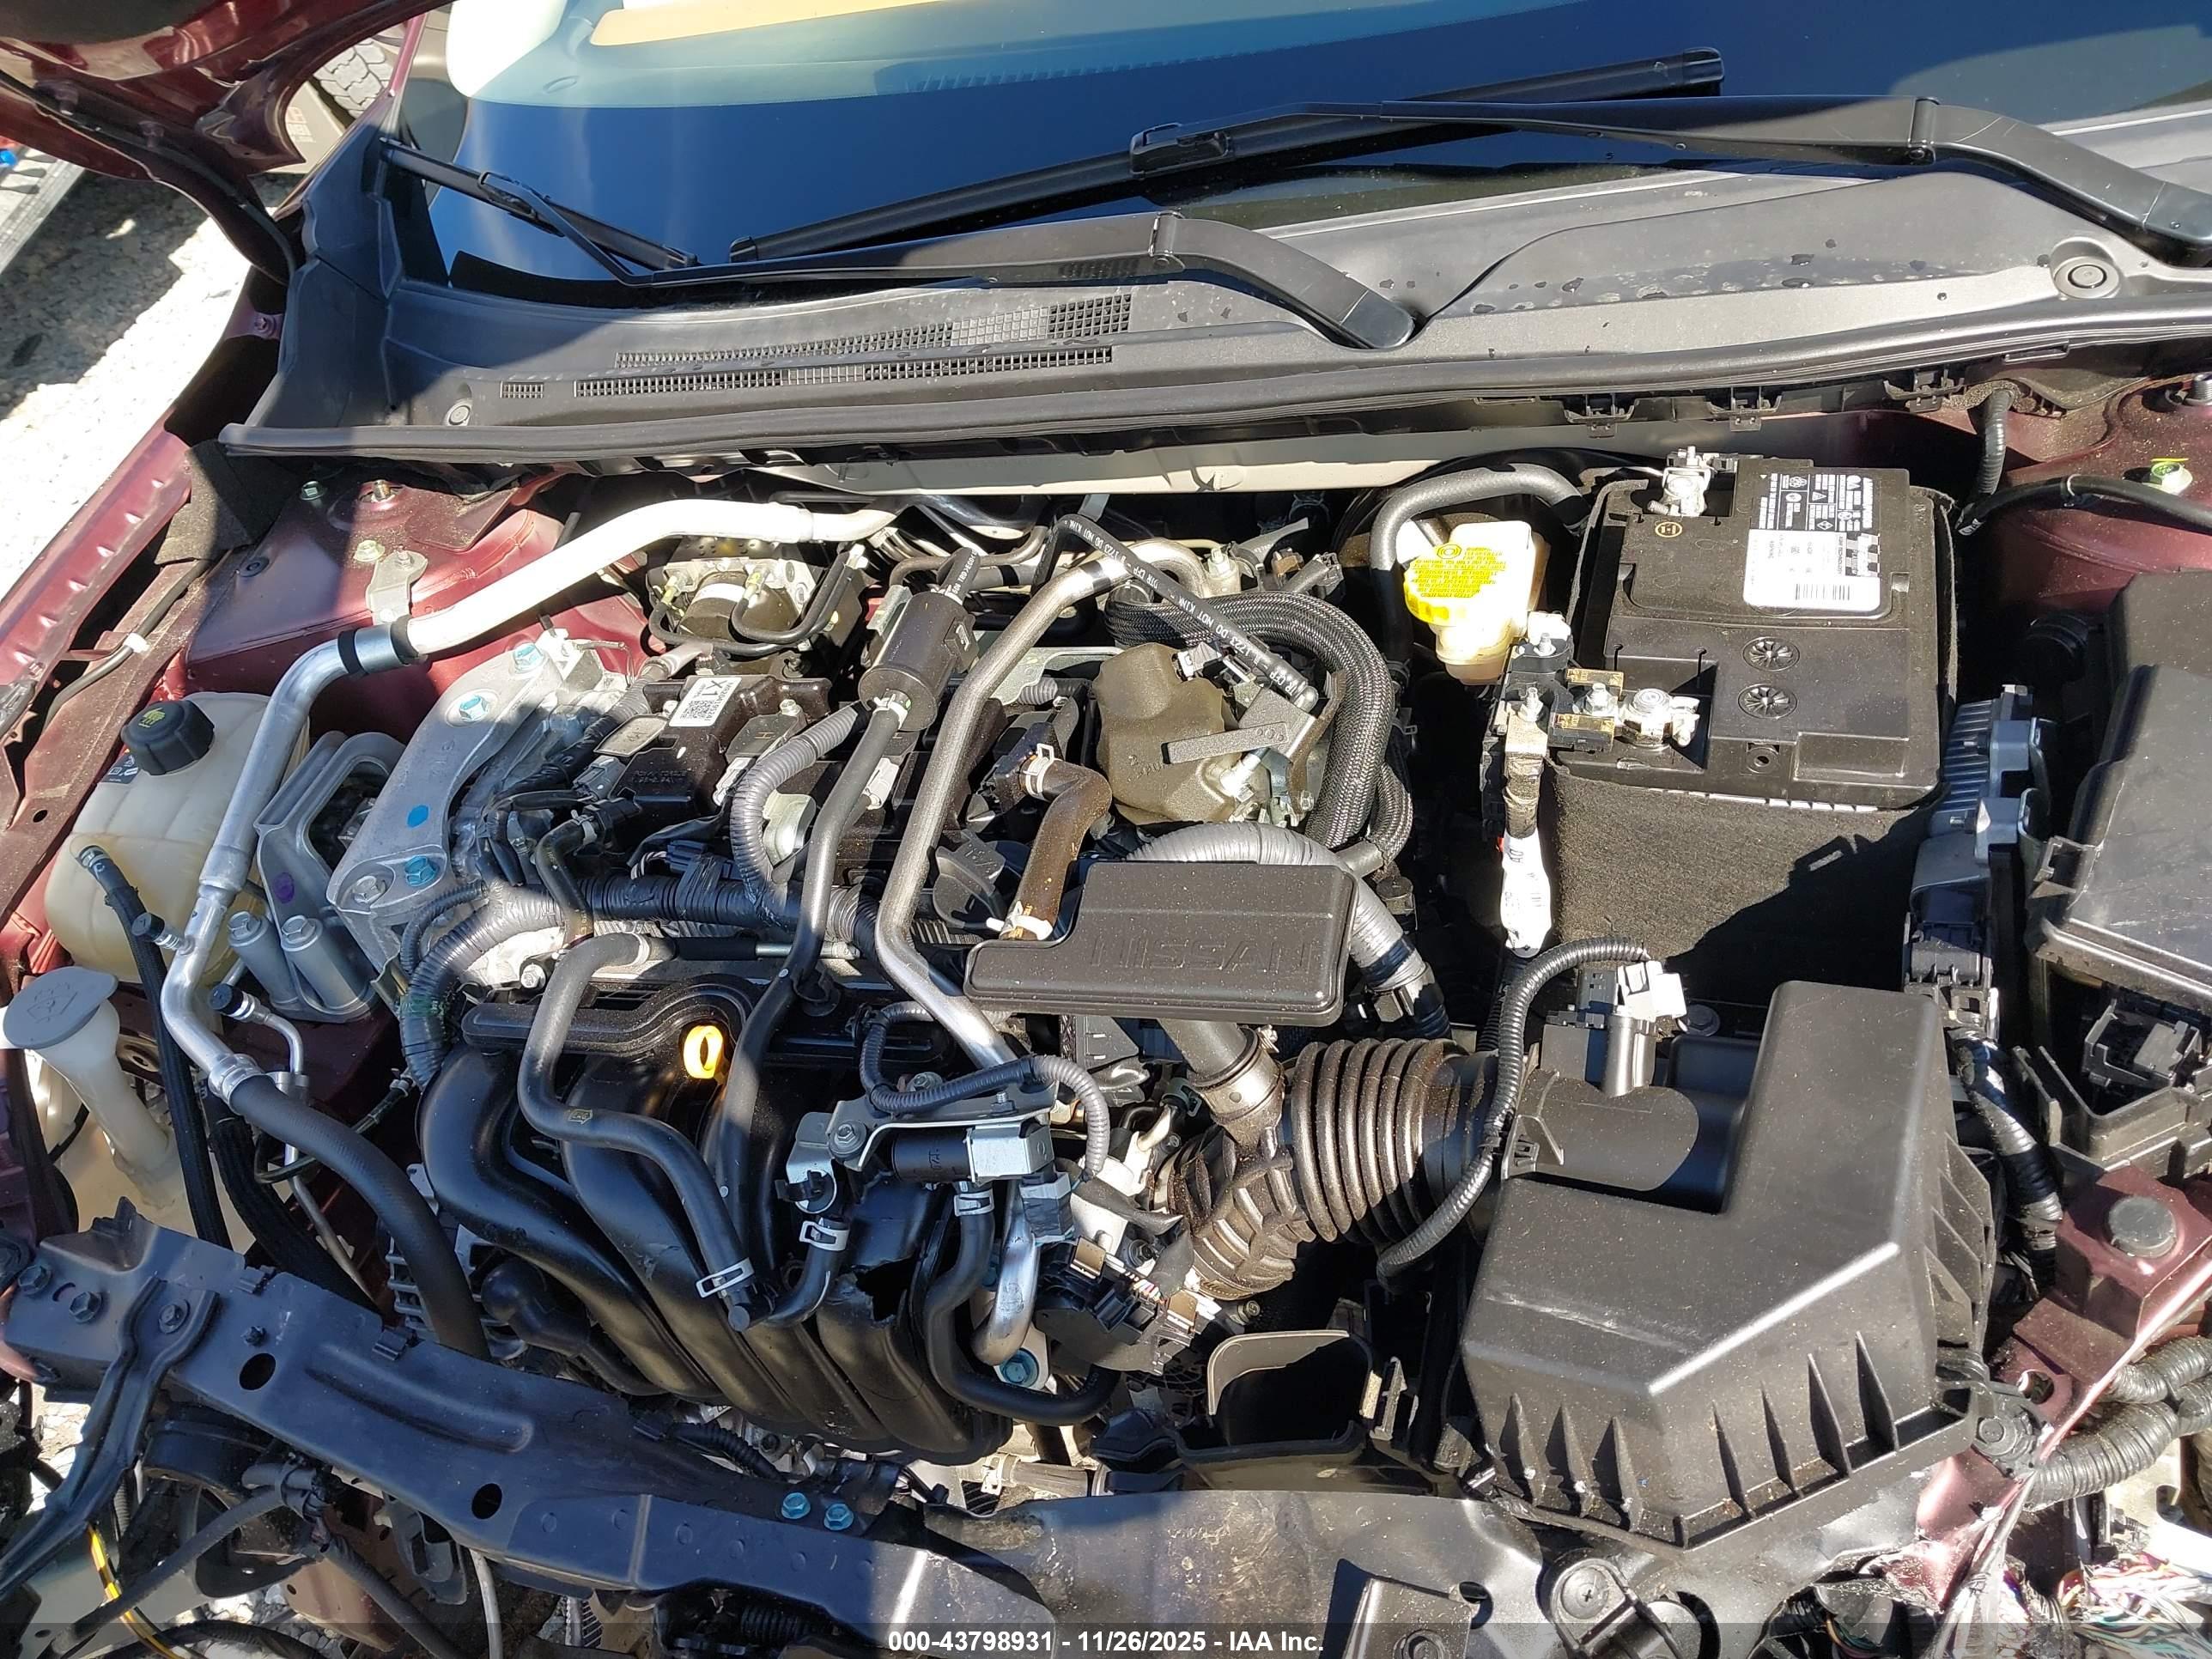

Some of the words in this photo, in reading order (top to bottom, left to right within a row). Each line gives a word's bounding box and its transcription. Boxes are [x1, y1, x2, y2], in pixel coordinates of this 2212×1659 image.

[1069, 520, 1083, 534] KINK
[1084, 528, 1094, 542] NOT
[1197, 611, 1214, 628] NOT
[1215, 624, 1229, 639] DO
[702, 680, 727, 696] X1
